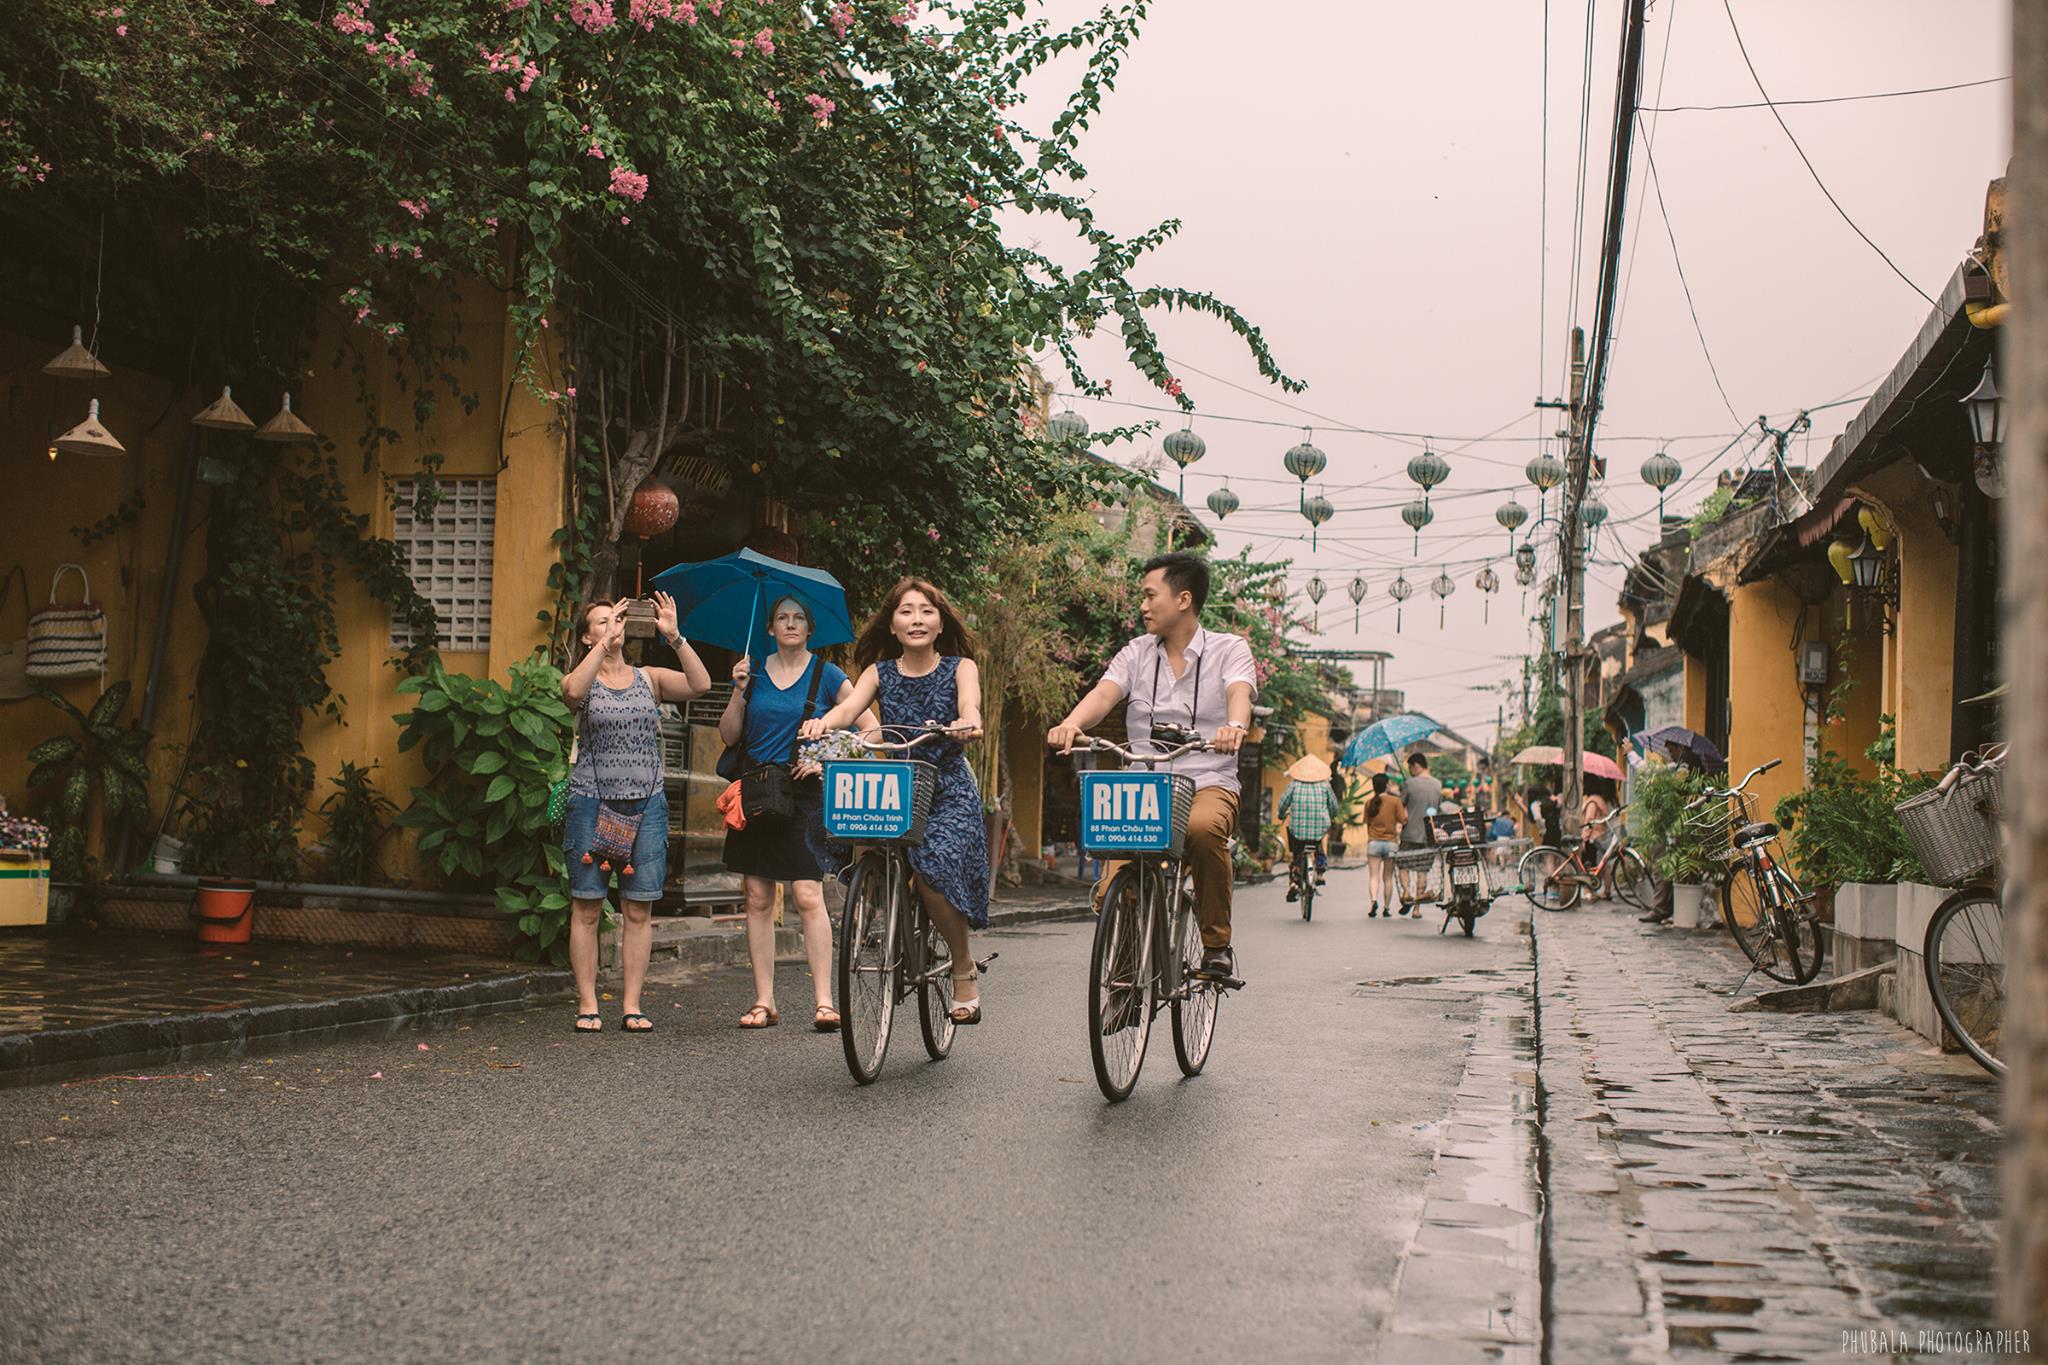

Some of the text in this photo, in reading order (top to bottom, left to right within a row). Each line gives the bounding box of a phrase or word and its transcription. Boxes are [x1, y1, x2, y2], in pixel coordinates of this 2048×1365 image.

[834, 773, 901, 810] RITA
[1093, 783, 1160, 820] RITA
[843, 813, 862, 821] Phan
[850, 823, 868, 831] 0906
[884, 824, 898, 832] 530
[1101, 824, 1121, 832] Phan
[1108, 834, 1127, 842] 0906
[1128, 834, 1142, 842] 414
[1143, 834, 1158, 842] 530
